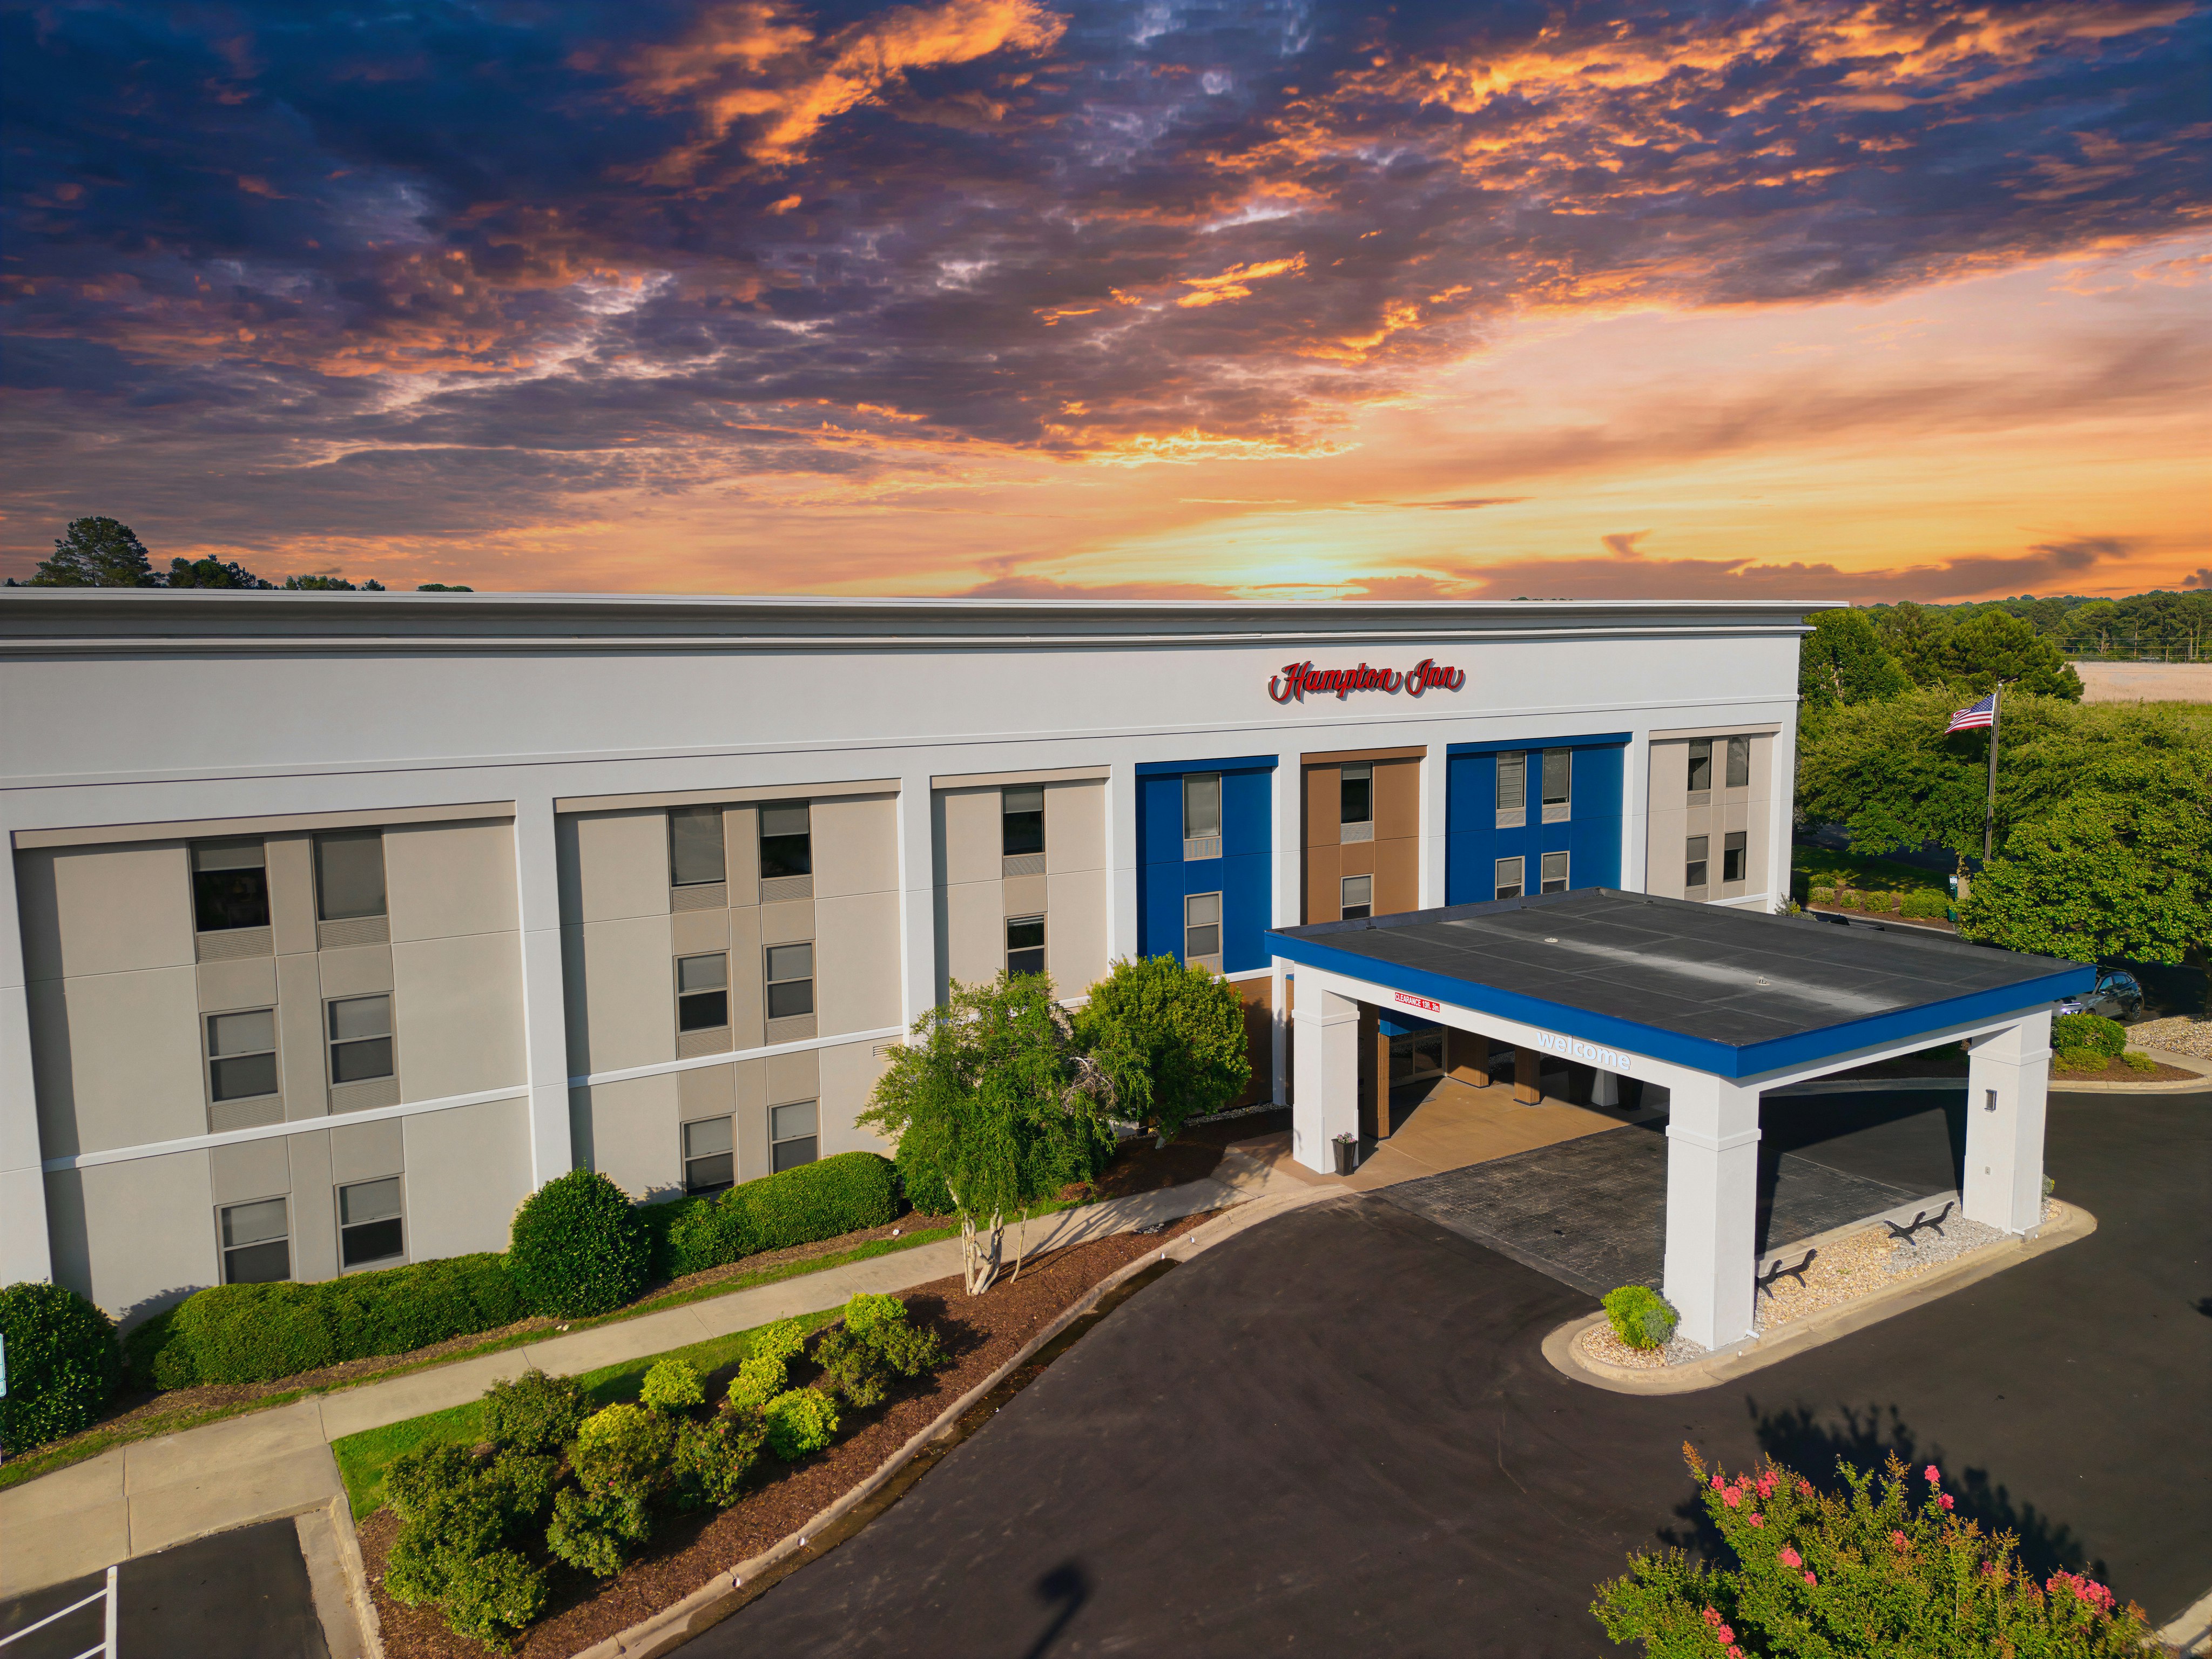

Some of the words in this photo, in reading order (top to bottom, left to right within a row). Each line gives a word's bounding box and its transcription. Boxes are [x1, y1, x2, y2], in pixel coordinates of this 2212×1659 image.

[1269, 660, 1402, 702] Hampton
[1405, 658, 1464, 696] Inn
[1395, 993, 1421, 1007] CLEARANCE
[1536, 1031, 1631, 1070] welcome
